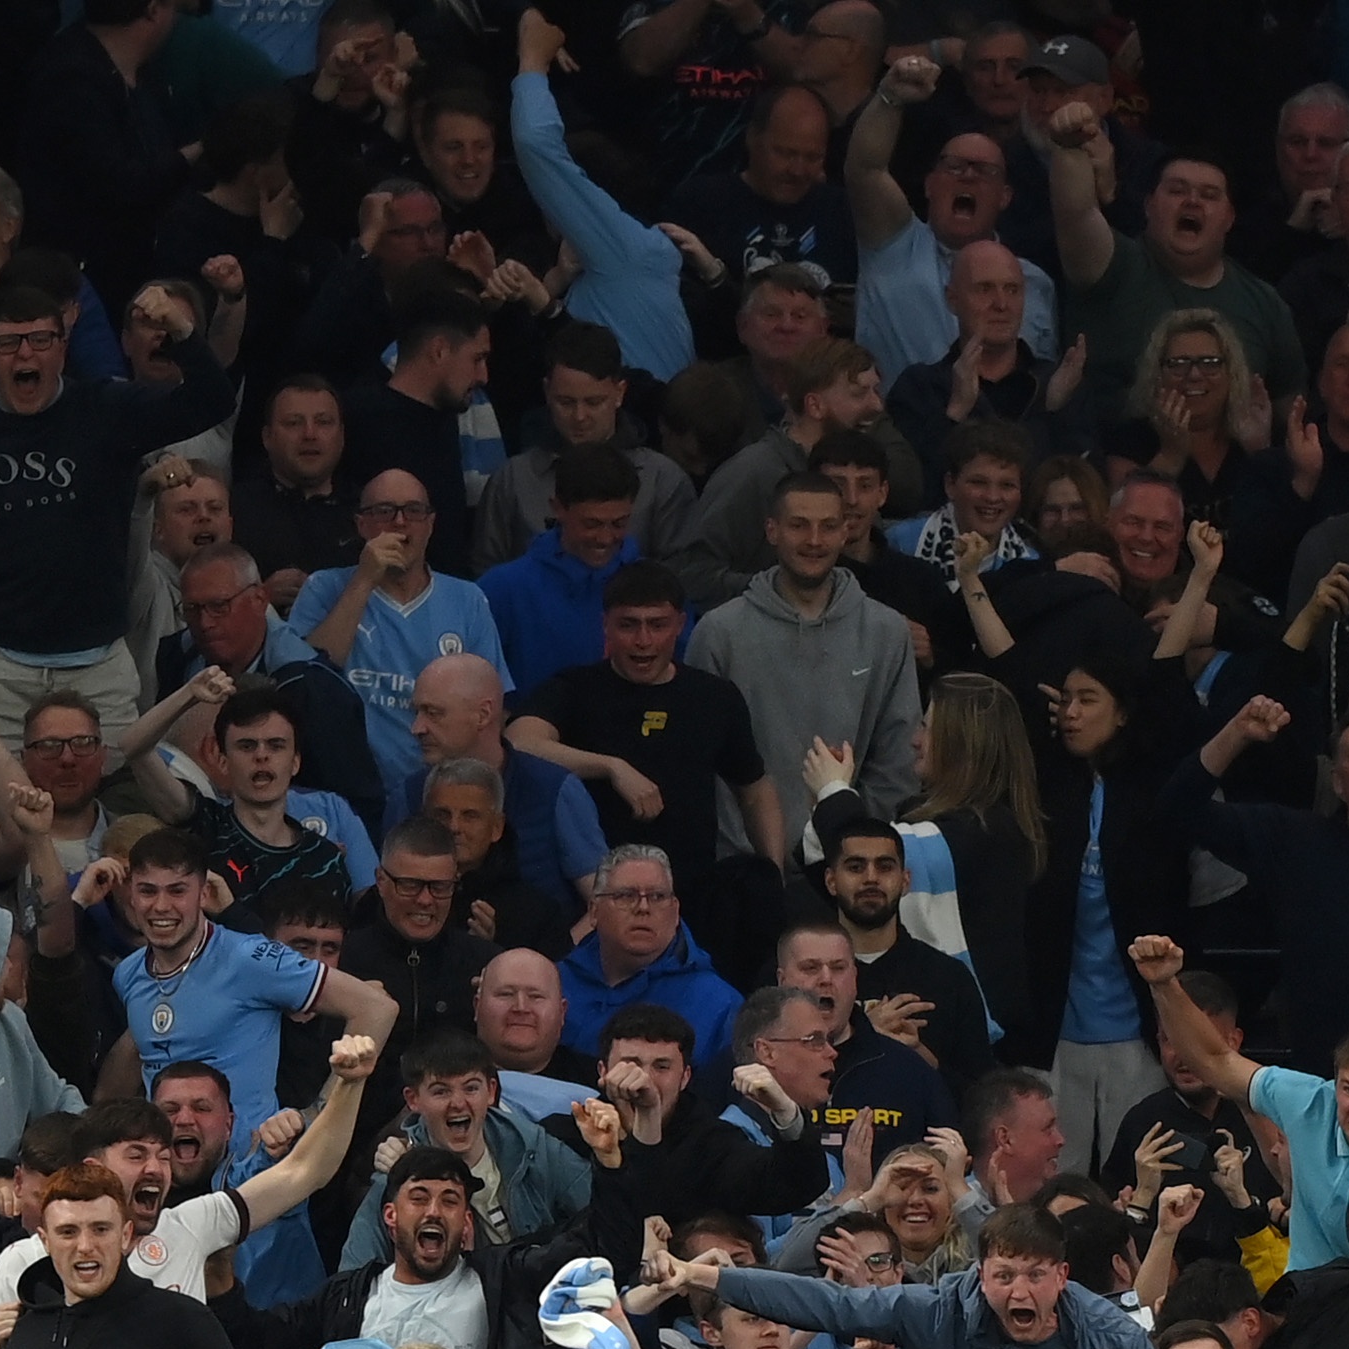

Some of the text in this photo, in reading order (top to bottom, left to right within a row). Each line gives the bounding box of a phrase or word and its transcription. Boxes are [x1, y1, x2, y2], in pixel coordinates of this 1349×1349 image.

[25, 491, 77, 508] BOSS
[348, 668, 416, 693] ETIH
[369, 694, 413, 710] AIRW
[824, 1108, 903, 1127] SPRT
